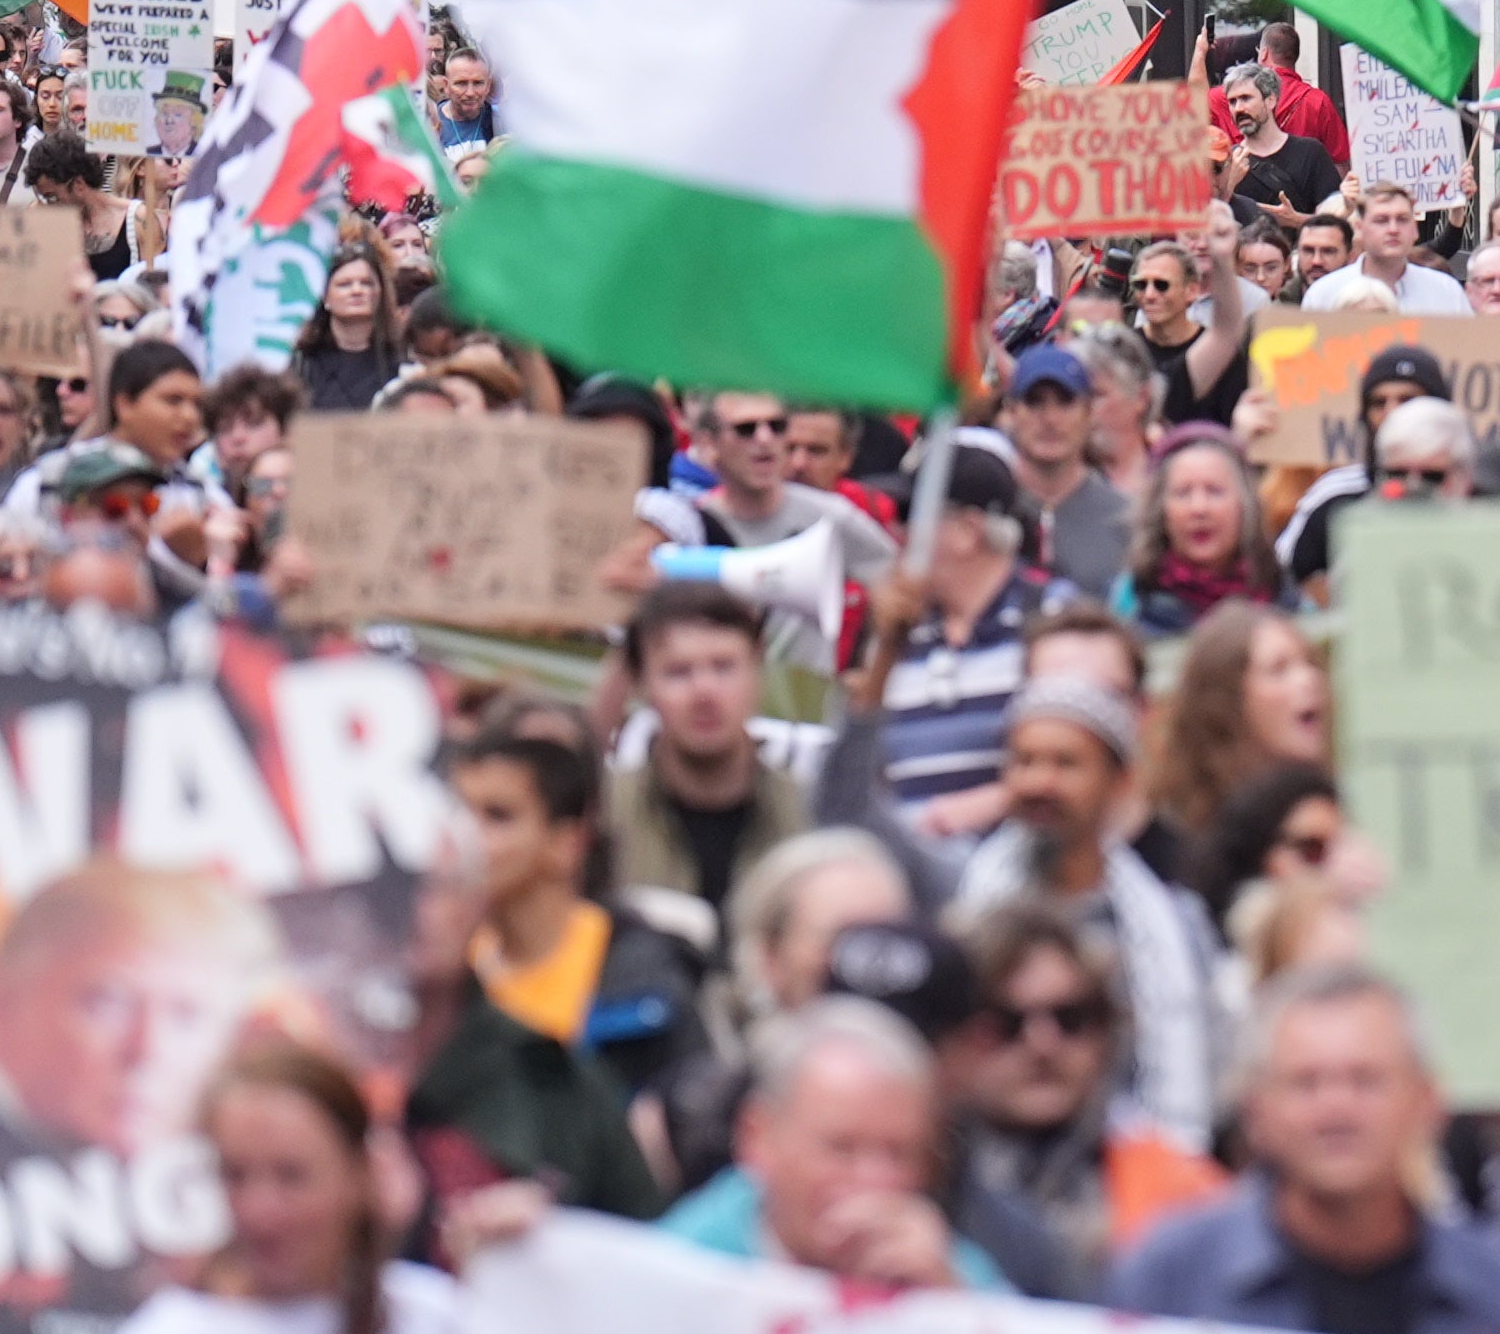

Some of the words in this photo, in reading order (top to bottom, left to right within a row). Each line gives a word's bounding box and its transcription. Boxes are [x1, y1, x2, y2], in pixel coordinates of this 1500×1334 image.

[138, 5, 193, 19] PREPARED
[200, 9, 210, 21] A
[91, 21, 136, 35] SPECIAL
[144, 22, 179, 37] IRISH
[1023, 11, 1113, 60] TRUMP
[1038, 17, 1059, 32] GO
[101, 35, 169, 50] WELCOME
[108, 49, 133, 63] FOR
[140, 50, 169, 64] YOU
[1051, 41, 1101, 73] YOU
[92, 70, 144, 90] FUCK
[1120, 84, 1197, 124] YOUR
[1373, 102, 1419, 127] SAM
[89, 122, 138, 143] HOME
[1364, 127, 1447, 156] SMEARTHA
[1365, 160, 1385, 183] LE
[1003, 163, 1081, 224] DO
